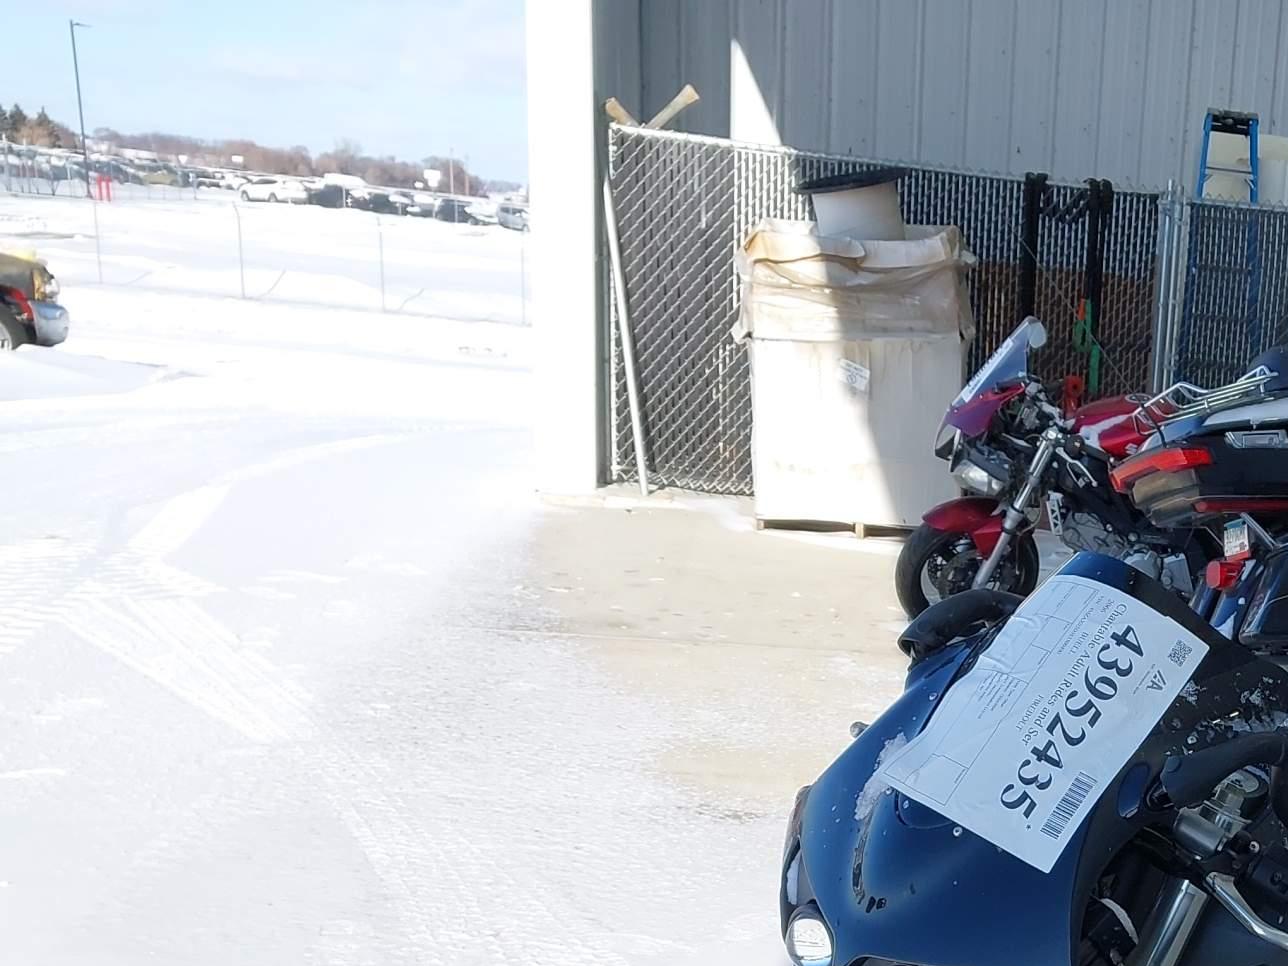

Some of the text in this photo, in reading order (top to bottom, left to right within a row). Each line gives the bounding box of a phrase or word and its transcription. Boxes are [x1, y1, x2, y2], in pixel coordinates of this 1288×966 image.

[1087, 603, 1128, 649] Charitable
[1067, 631, 1089, 655] BUELL
[1067, 649, 1091, 678] Adult
[1047, 678, 1073, 707] Rides
[1000, 624, 1144, 820] 43952435
[1033, 706, 1050, 728] and
[1021, 726, 1039, 747] Ser
